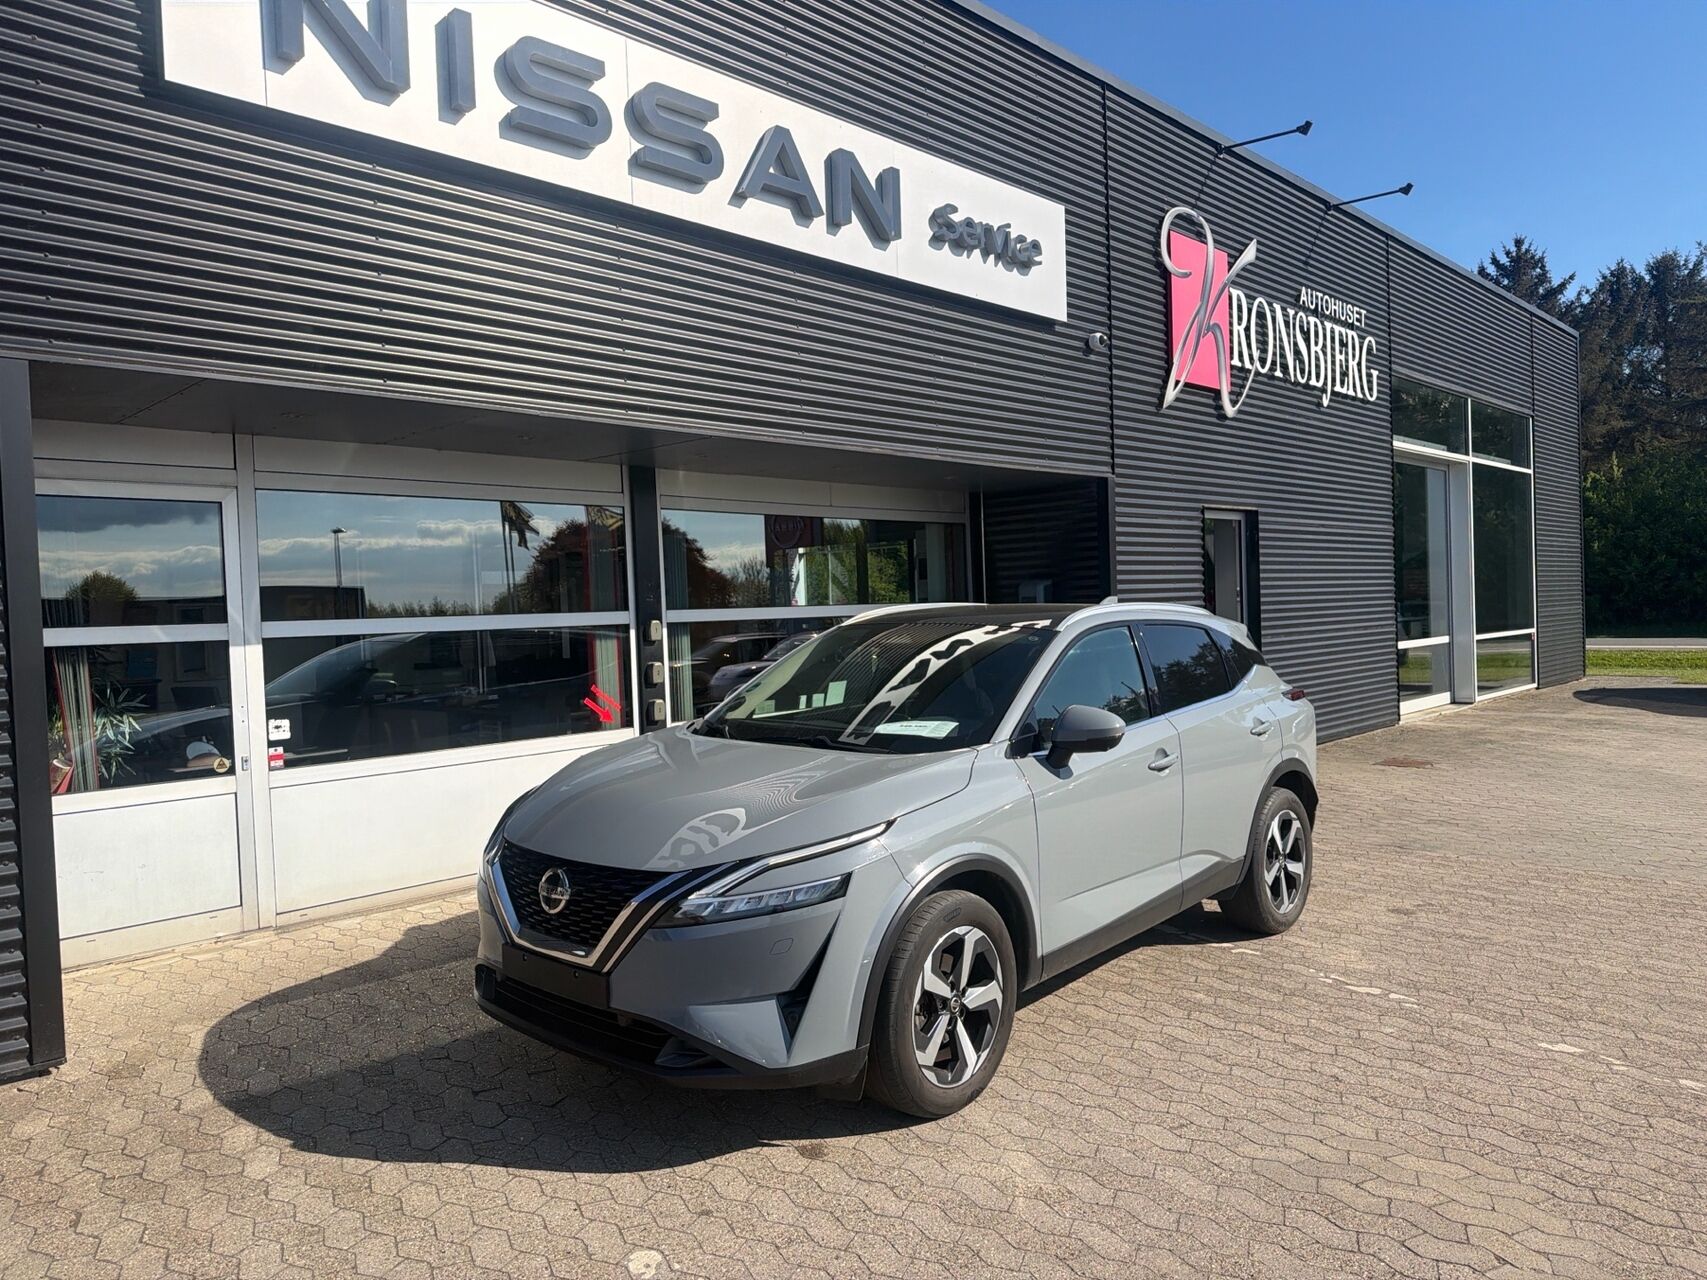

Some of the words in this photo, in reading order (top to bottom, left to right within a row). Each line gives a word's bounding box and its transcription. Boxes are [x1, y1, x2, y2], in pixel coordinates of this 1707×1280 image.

[267, 0, 902, 247] NISSAN
[929, 203, 1043, 272] Service
[1299, 286, 1367, 328] AUTOHUSET
